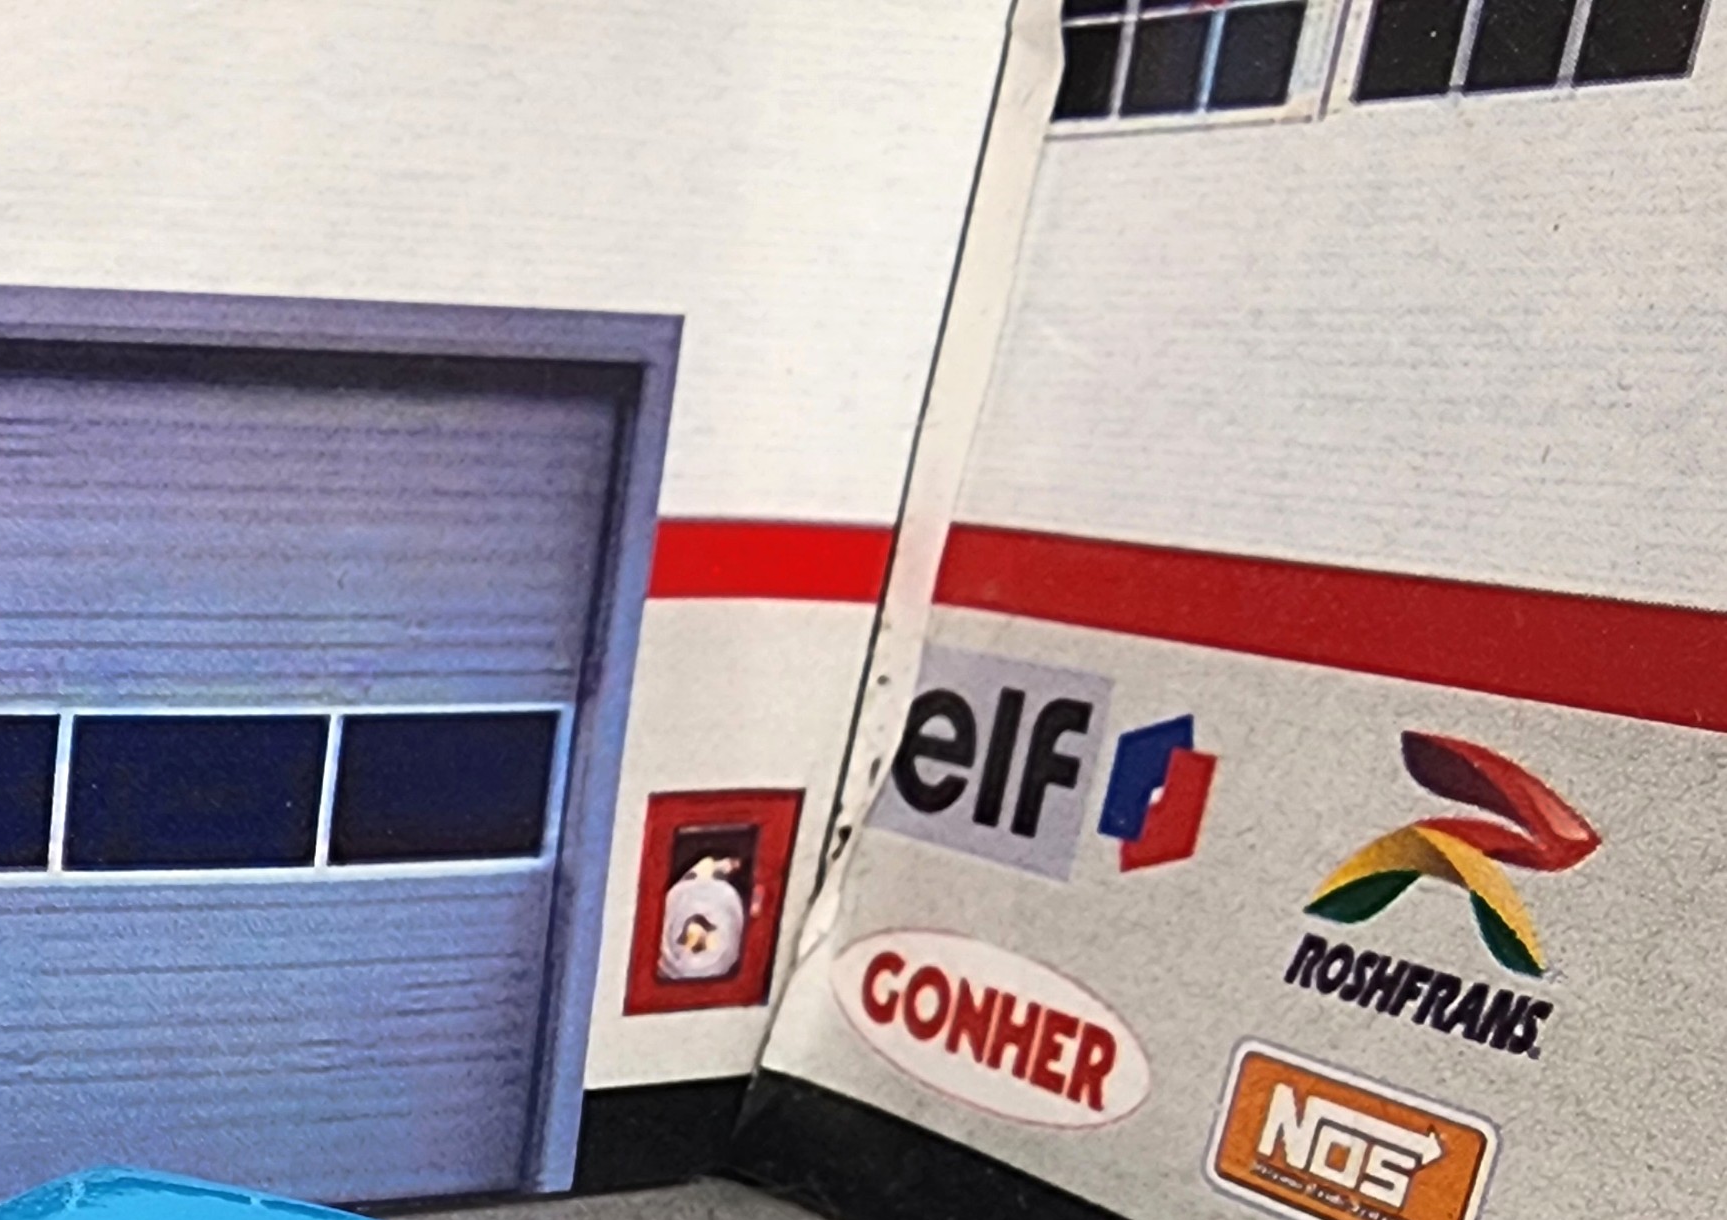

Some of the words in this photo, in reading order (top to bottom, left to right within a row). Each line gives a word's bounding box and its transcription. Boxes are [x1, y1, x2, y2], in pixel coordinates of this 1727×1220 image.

[892, 687, 1093, 838] elf
[862, 952, 1116, 1111] GONHER
[1258, 1083, 1442, 1207] NOS
